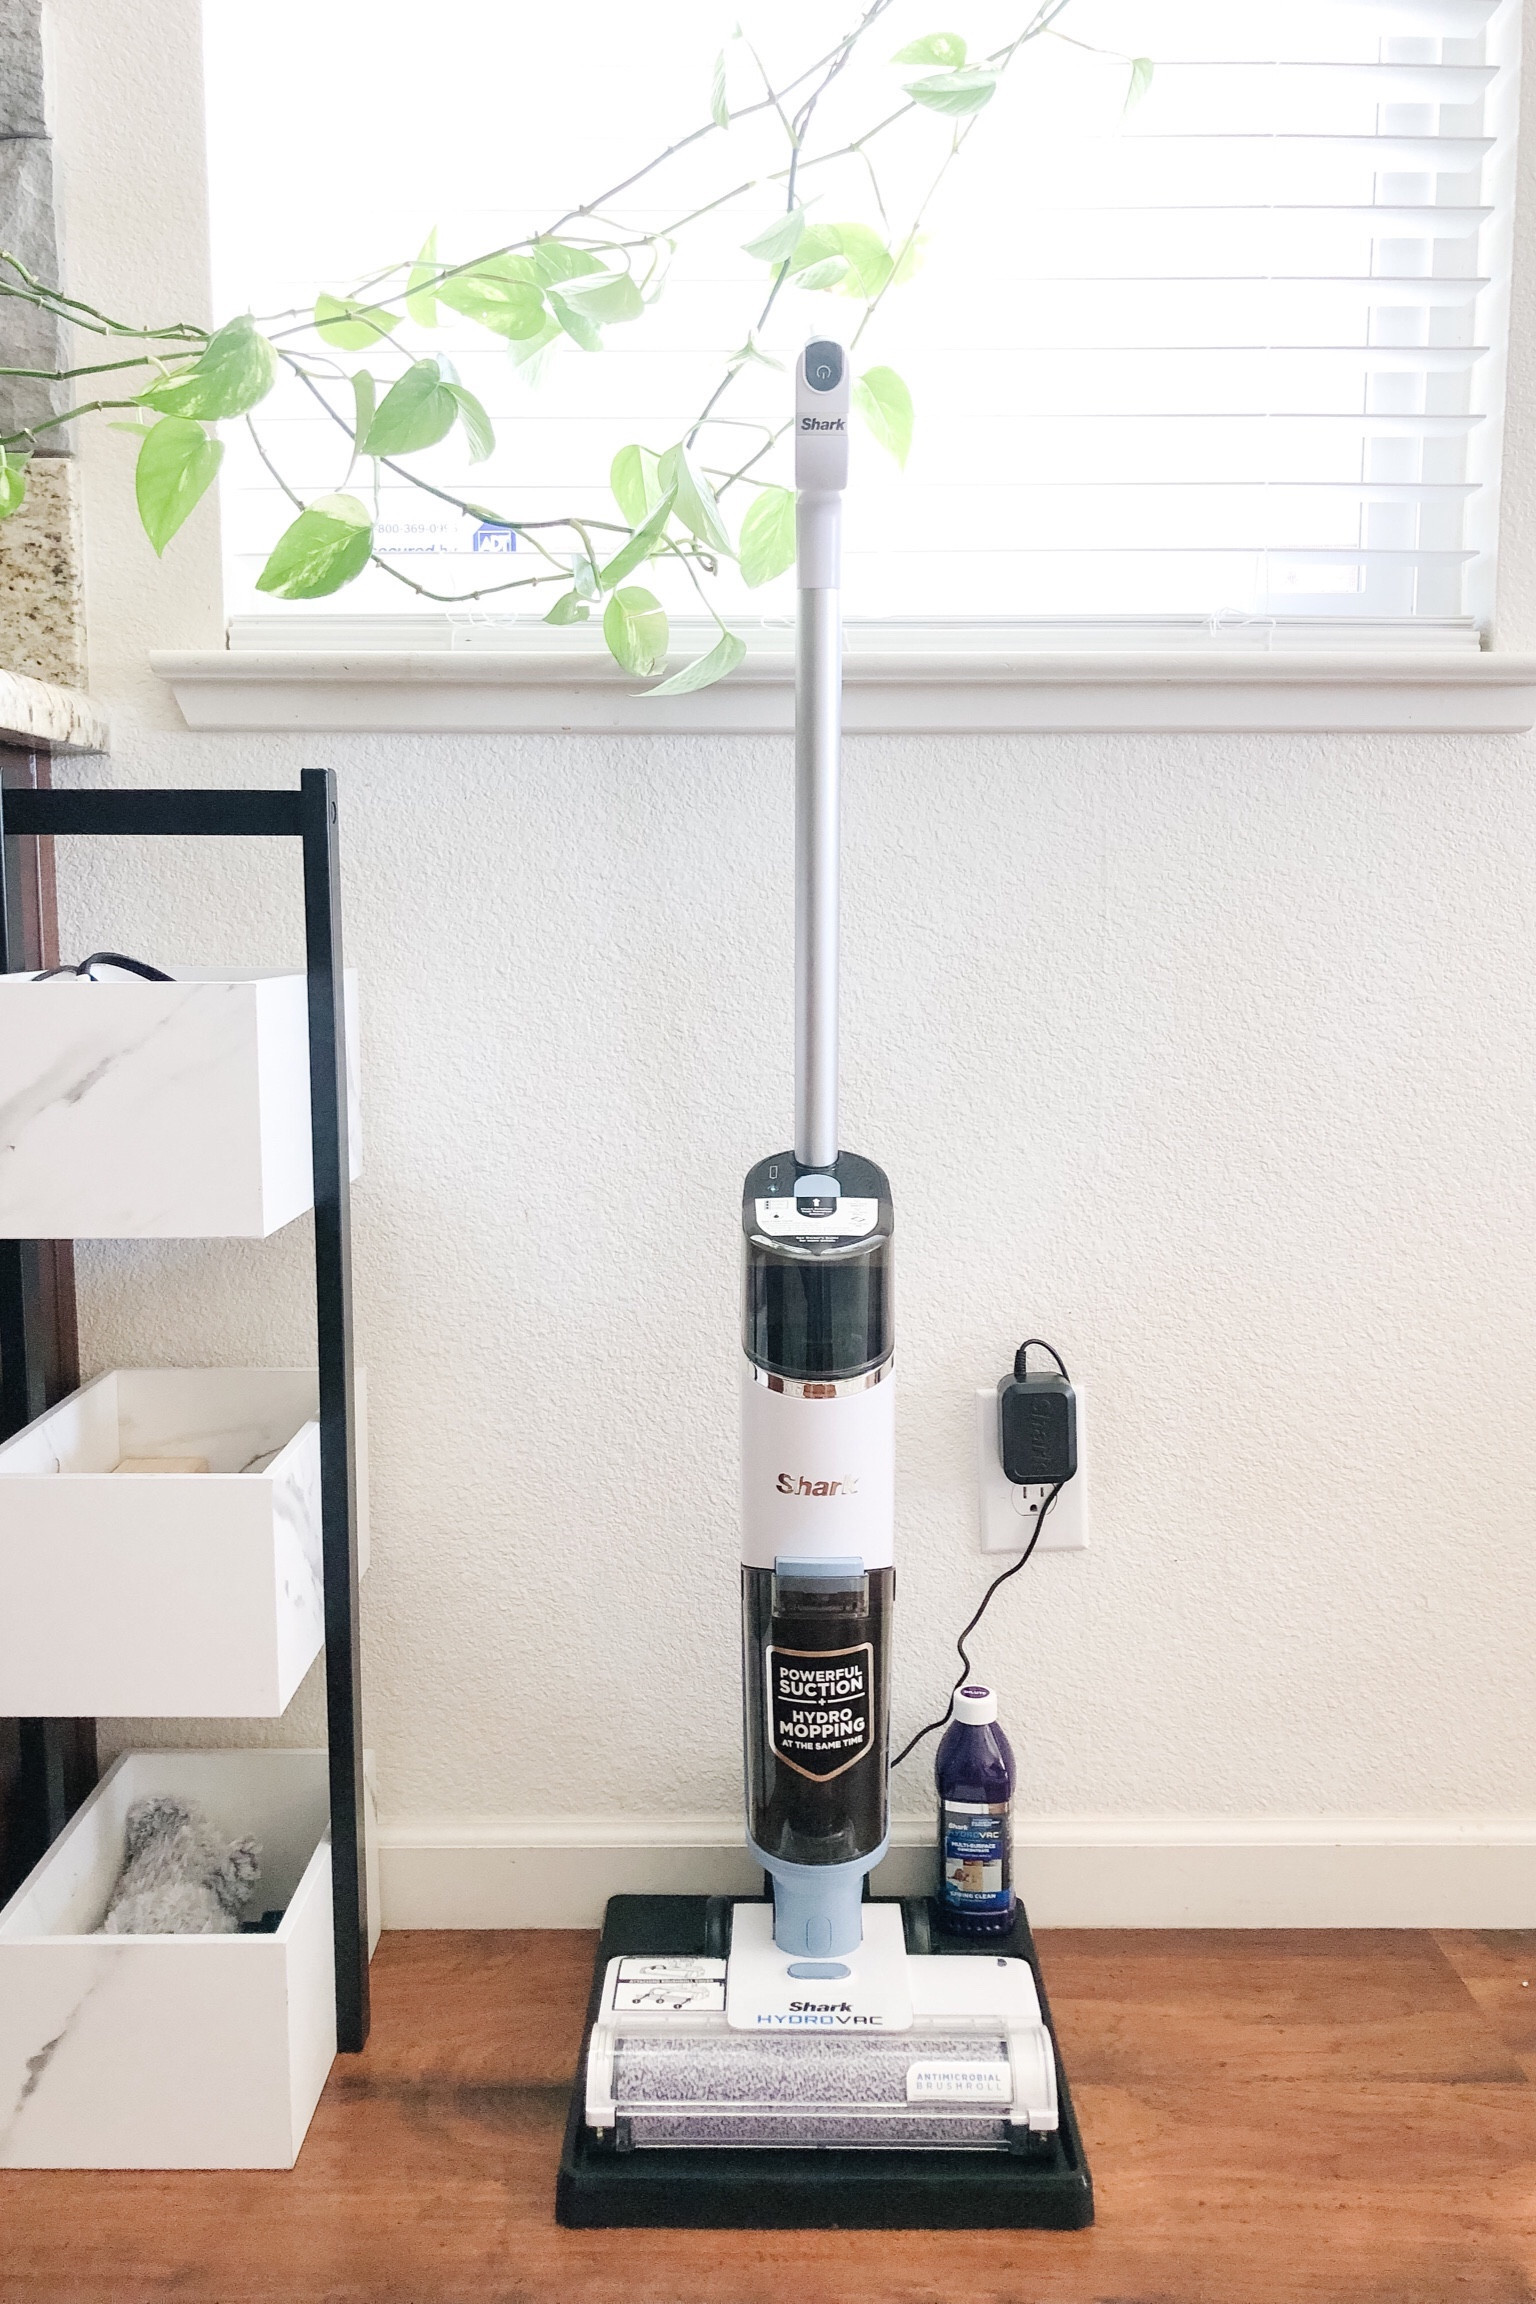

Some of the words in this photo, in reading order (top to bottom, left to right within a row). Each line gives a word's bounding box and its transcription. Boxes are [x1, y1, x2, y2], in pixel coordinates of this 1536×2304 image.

[801, 417, 846, 431] Shark
[780, 1665, 862, 1682] POWERFUL
[780, 1676, 863, 1696] SUCTION
[792, 1708, 852, 1724] HYDRO
[780, 1717, 865, 1738] MOPPING
[782, 1739, 793, 1748] AT
[795, 1741, 813, 1750] THE
[815, 1740, 841, 1750] SAME
[843, 1735, 863, 1747] TIME
[788, 2001, 854, 2013] Shark
[757, 2015, 883, 2025] HYDROVAC
[917, 2073, 1000, 2082] ANTIMICROBIAL
[917, 2082, 1001, 2091] BRUSHROLL
